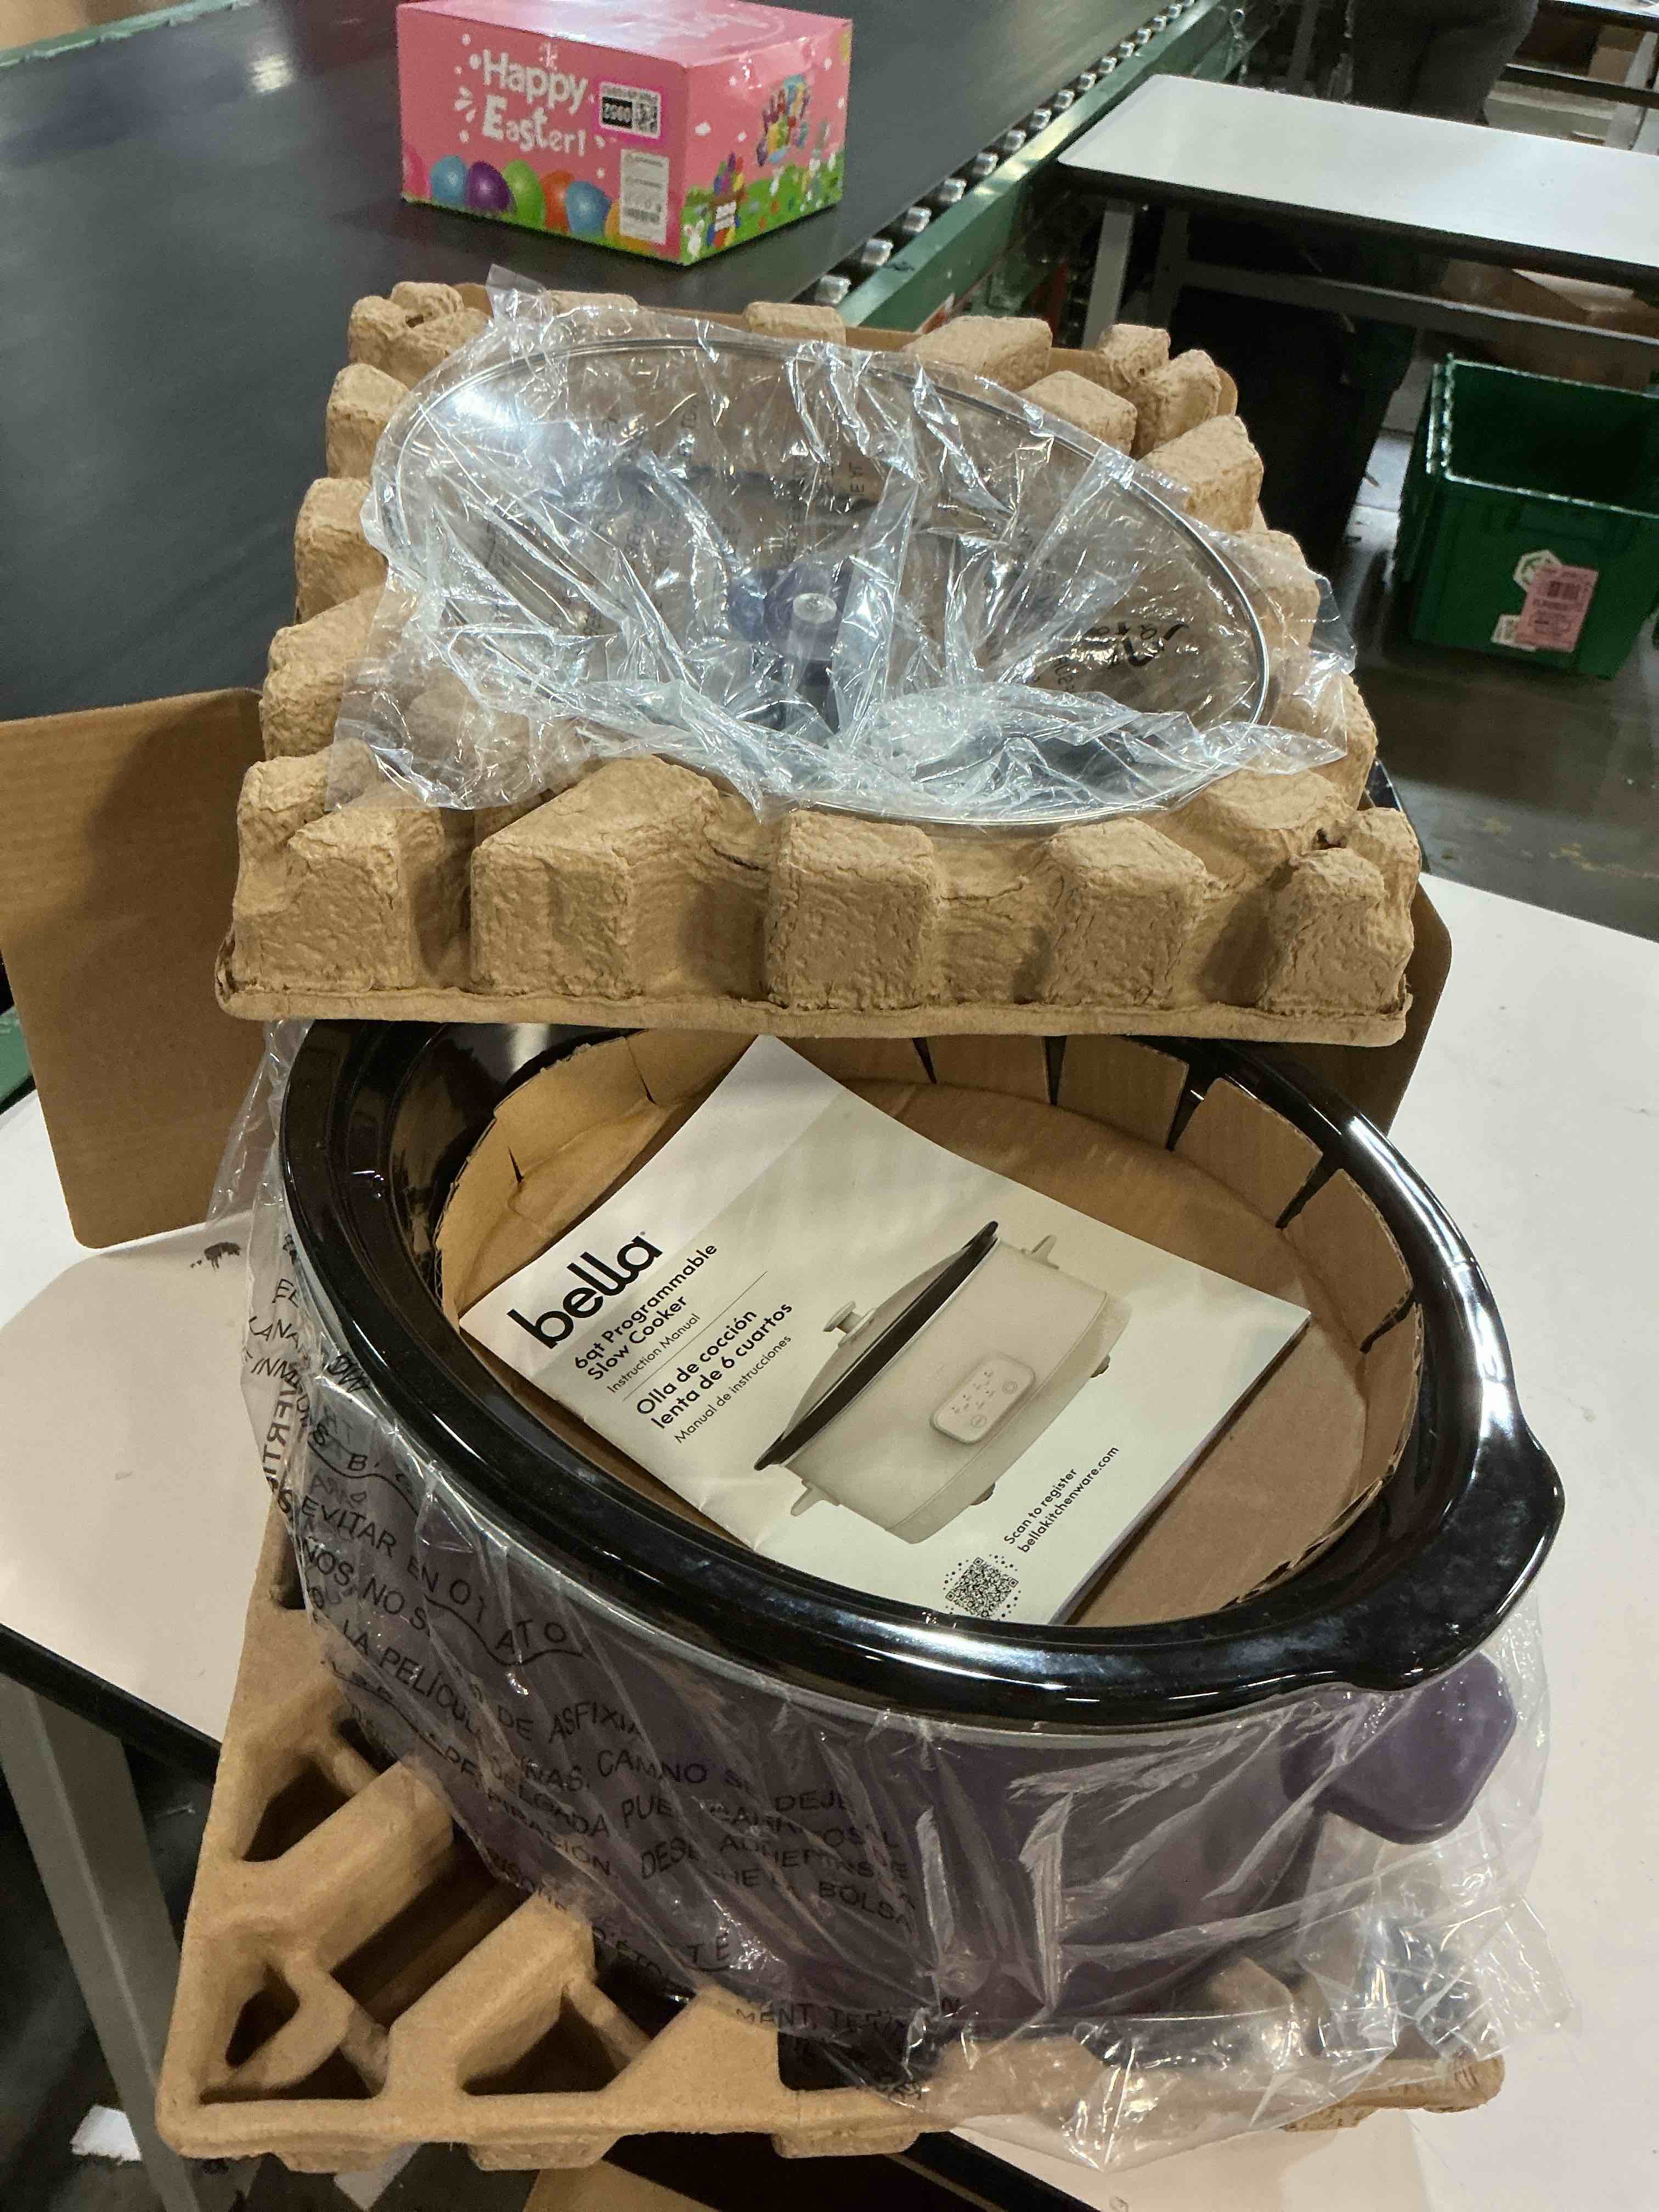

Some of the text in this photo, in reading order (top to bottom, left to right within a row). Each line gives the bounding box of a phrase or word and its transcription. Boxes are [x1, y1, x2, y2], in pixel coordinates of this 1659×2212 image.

[482, 94, 586, 157] Easter!
[483, 48, 588, 115] Happy
[506, 1235, 663, 1350] bella
[575, 1245, 718, 1369] 6qt Programmable
[588, 1296, 687, 1380] Slow Cooker
[607, 1313, 701, 1393] Instruction Manual
[636, 1310, 758, 1414] Olla de cocción
[651, 1303, 793, 1430] lenta de 6 cuartos
[674, 1335, 792, 1444] Manual de instrucciones
[302, 1495, 397, 1558] EVITAR
[1004, 1468, 1077, 1545] Scan to register
[1017, 1446, 1120, 1553] bellakitchenware.com
